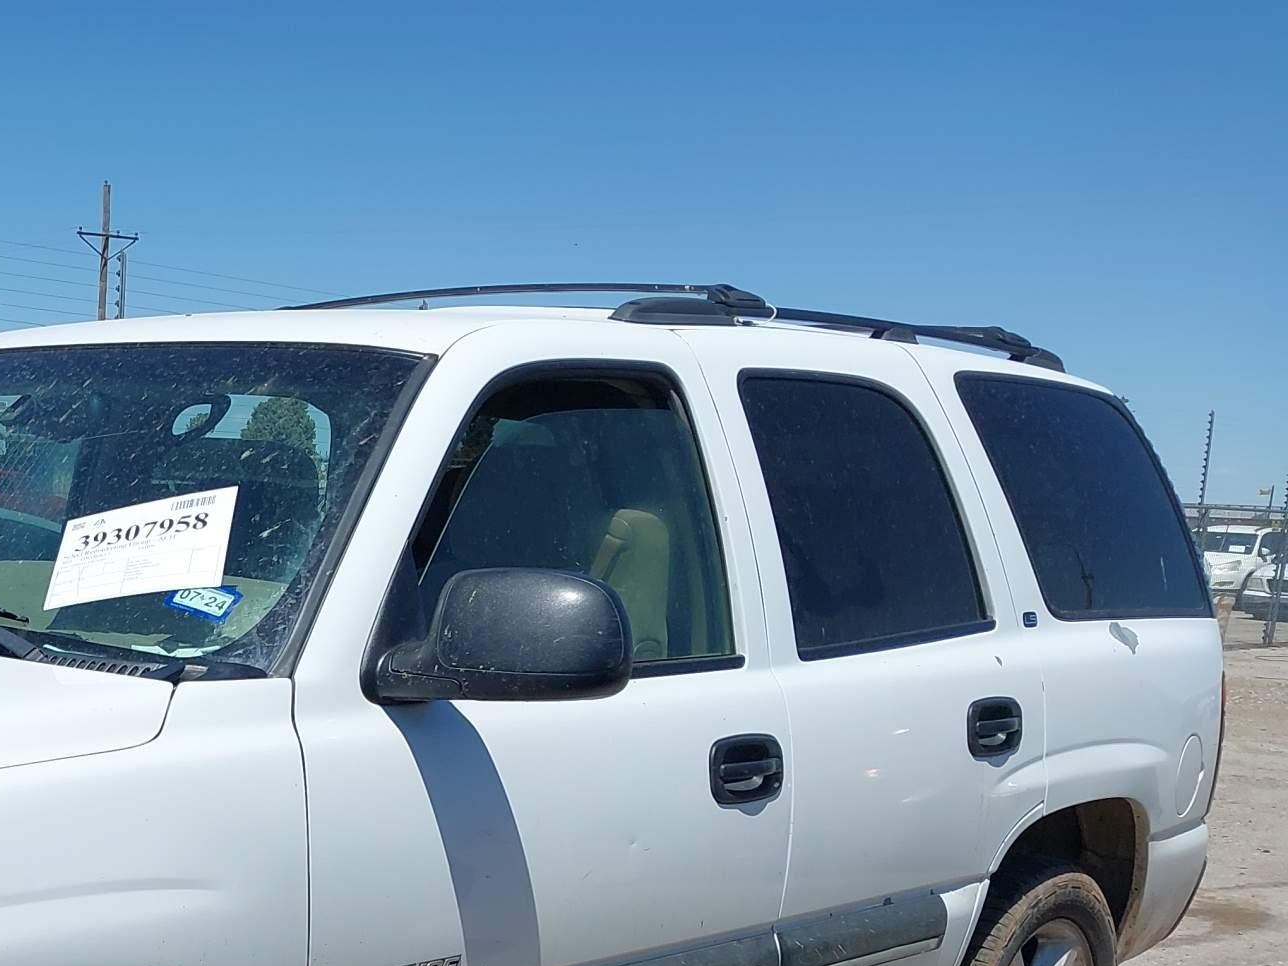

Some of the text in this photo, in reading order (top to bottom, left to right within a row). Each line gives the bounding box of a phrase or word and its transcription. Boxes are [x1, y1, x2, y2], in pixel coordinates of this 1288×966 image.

[75, 512, 209, 552] 39307958
[180, 588, 201, 602] 07
[204, 596, 227, 611] 24
